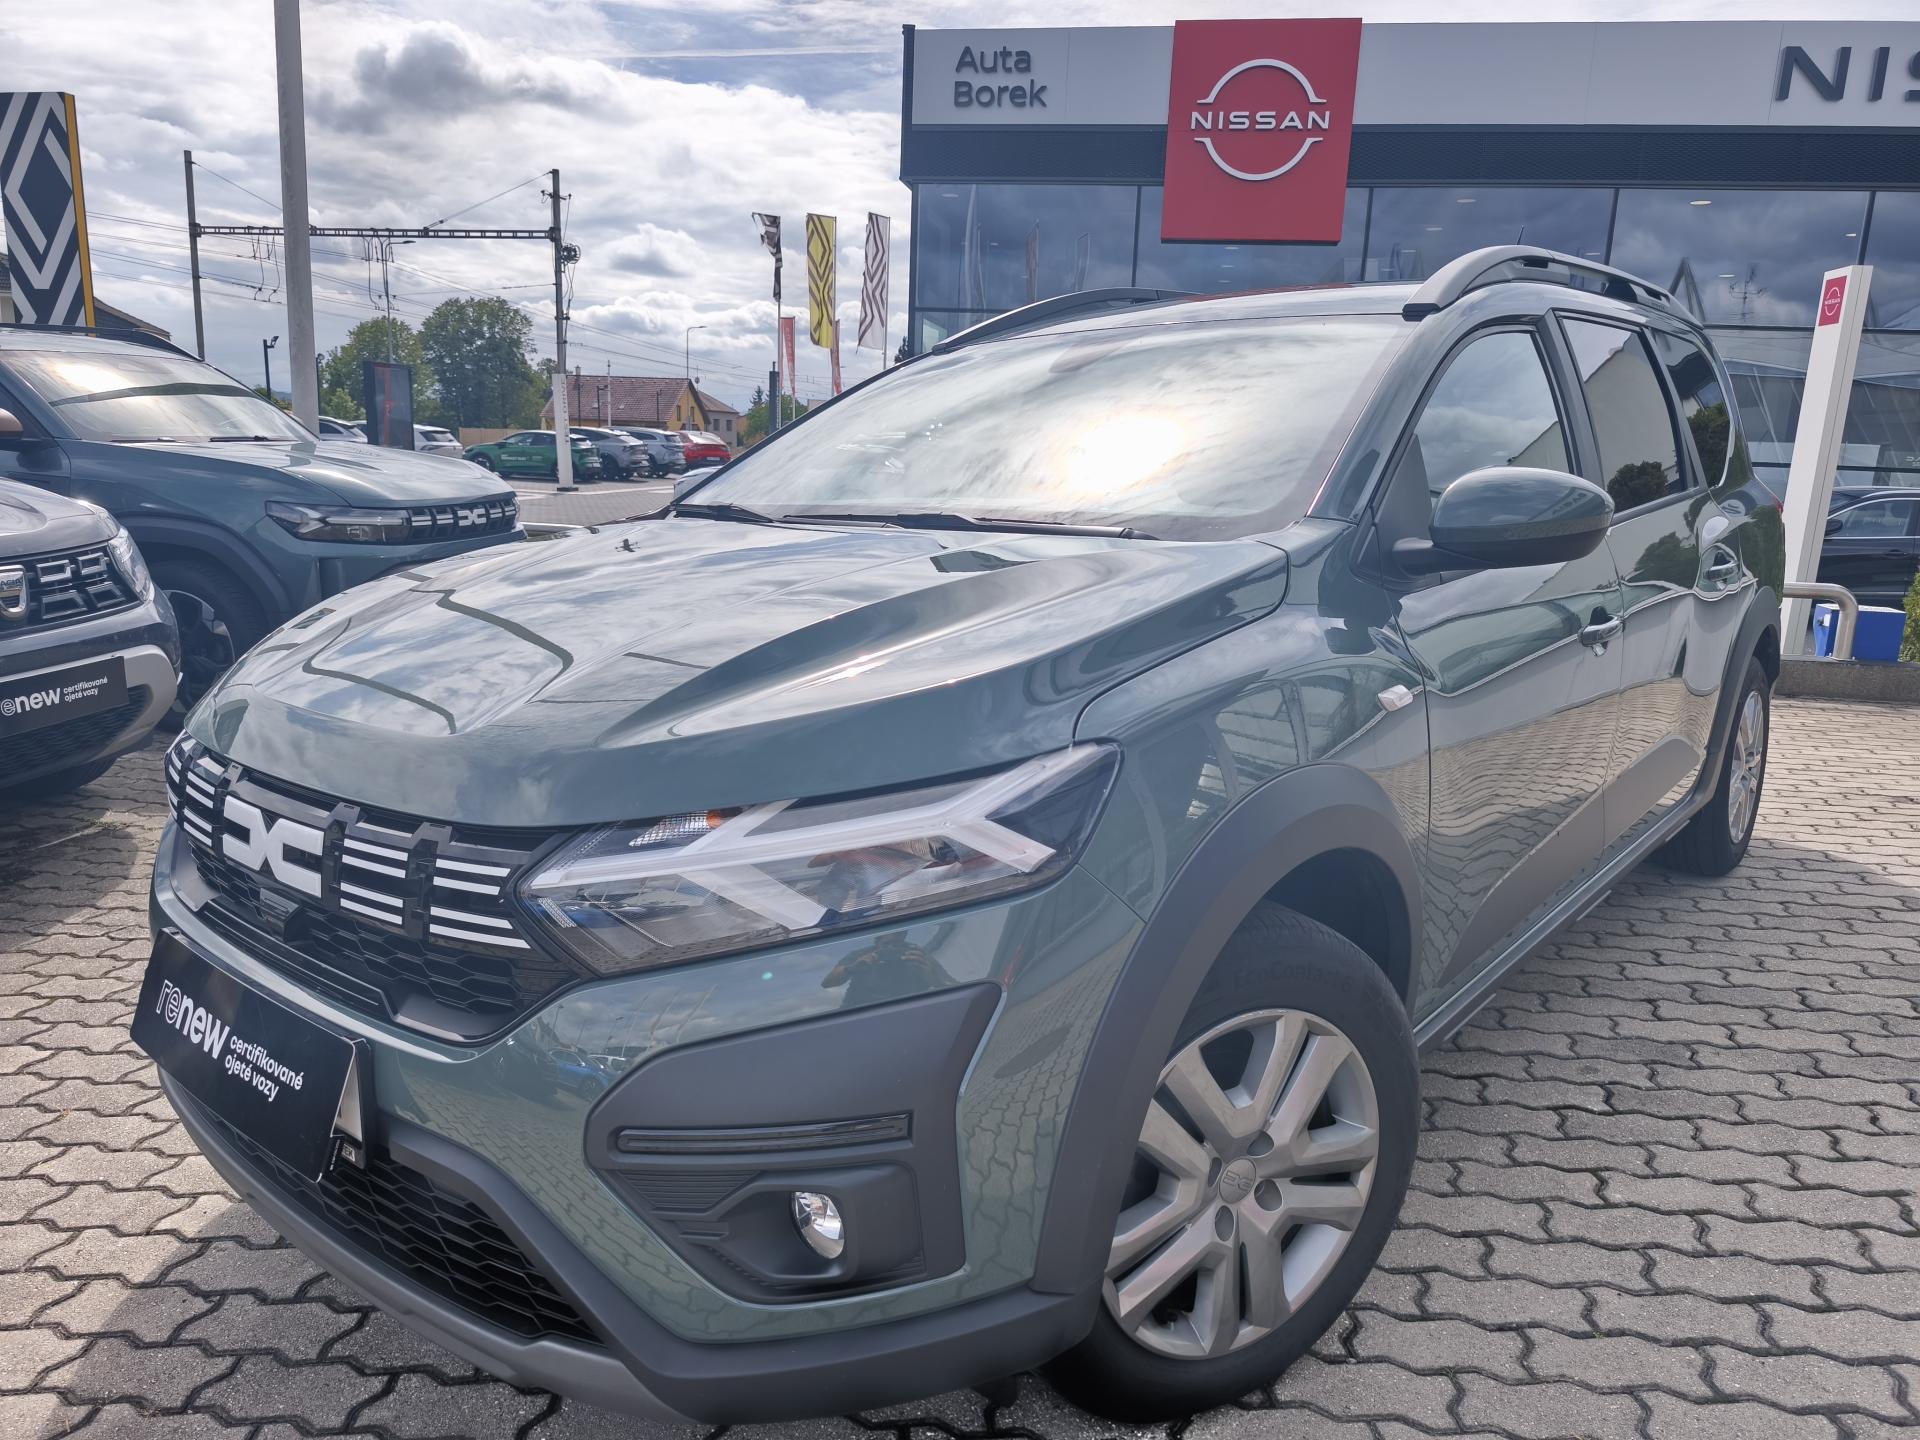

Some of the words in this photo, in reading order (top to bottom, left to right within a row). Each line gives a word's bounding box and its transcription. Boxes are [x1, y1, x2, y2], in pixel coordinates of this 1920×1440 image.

[955, 46, 1031, 74] Auta
[1775, 46, 1920, 103] NI
[954, 79, 1047, 108] Borek
[1190, 110, 1330, 131] NISSAN
[0, 578, 24, 588] ACIA
[0, 687, 61, 716] enew
[63, 675, 108, 694] certifikované
[64, 690, 83, 702] ojeté
[83, 687, 99, 697] vozy
[155, 979, 230, 1060] renew
[230, 1035, 305, 1091] certifikované
[224, 1053, 252, 1082] ojeté
[252, 1071, 279, 1102] vozy
